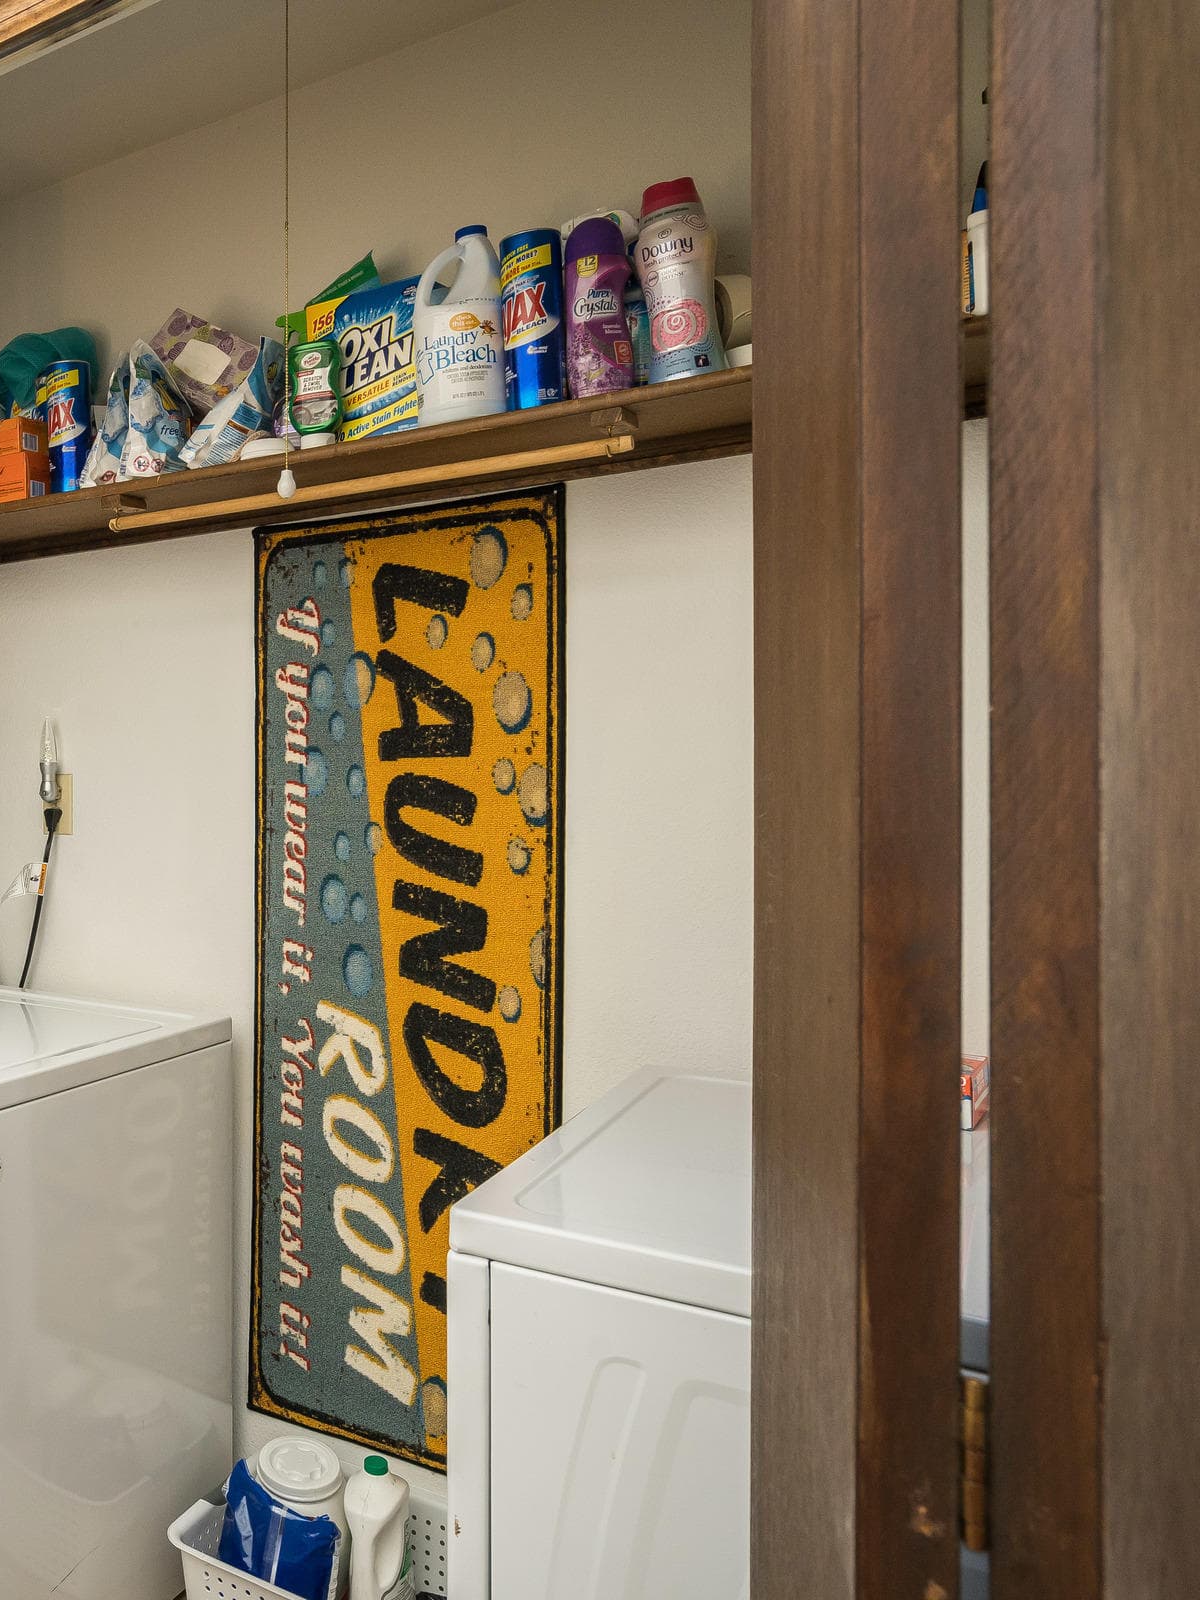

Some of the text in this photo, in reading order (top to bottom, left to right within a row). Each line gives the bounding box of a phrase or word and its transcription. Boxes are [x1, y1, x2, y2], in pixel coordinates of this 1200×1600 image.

[516, 250, 538, 264] MORE?
[583, 256, 596, 266] 12
[641, 237, 694, 262] Downy
[573, 296, 618, 320] Crystals
[587, 289, 610, 299] Purex
[312, 310, 334, 333] 156
[315, 325, 333, 341] LOADS
[516, 318, 548, 335] BLEACH
[339, 316, 393, 368] OXI
[424, 331, 479, 350] Laundry
[341, 333, 415, 396] LEAN
[435, 343, 497, 371] Bleach
[347, 379, 390, 407] VERSATILE
[392, 372, 416, 388] REMOVER
[347, 420, 371, 439] Active
[372, 411, 393, 428] Stain
[393, 399, 418, 417] Fighte
[276, 597, 321, 657] If
[275, 661, 311, 766] you
[282, 780, 310, 927] wear
[371, 561, 508, 1314] LAUNDR
[280, 1017, 317, 1130] You
[279, 1141, 313, 1289] wash
[316, 1000, 419, 1407] ROOM
[279, 1301, 313, 1372] it!
